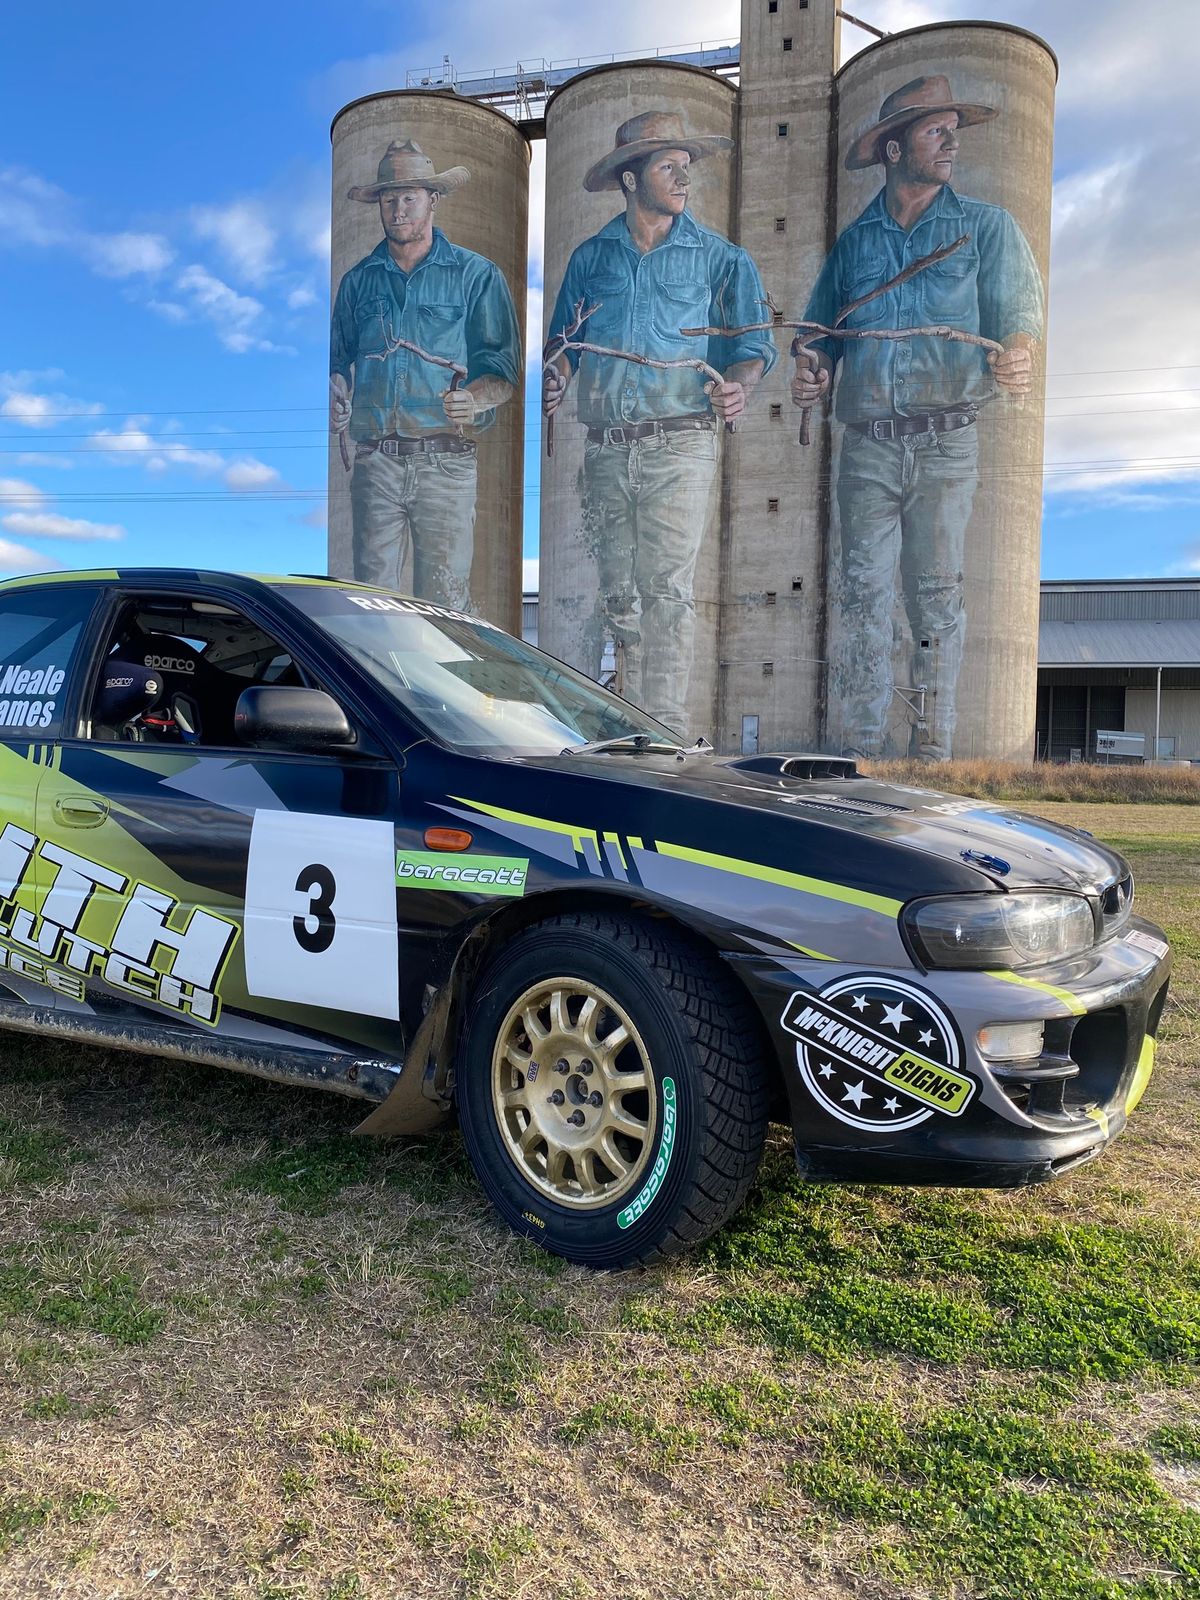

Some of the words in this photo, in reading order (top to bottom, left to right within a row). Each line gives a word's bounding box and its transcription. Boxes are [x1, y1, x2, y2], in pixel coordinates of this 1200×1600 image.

[0, 665, 66, 695] Neale
[144, 654, 195, 672] sparco
[105, 677, 134, 688] sparco
[397, 861, 526, 885] baracatt
[293, 863, 336, 953] 3
[0, 906, 217, 1022] UTCH
[891, 1059, 962, 1102] SIGNS
[624, 1104, 675, 1223] baracatt
